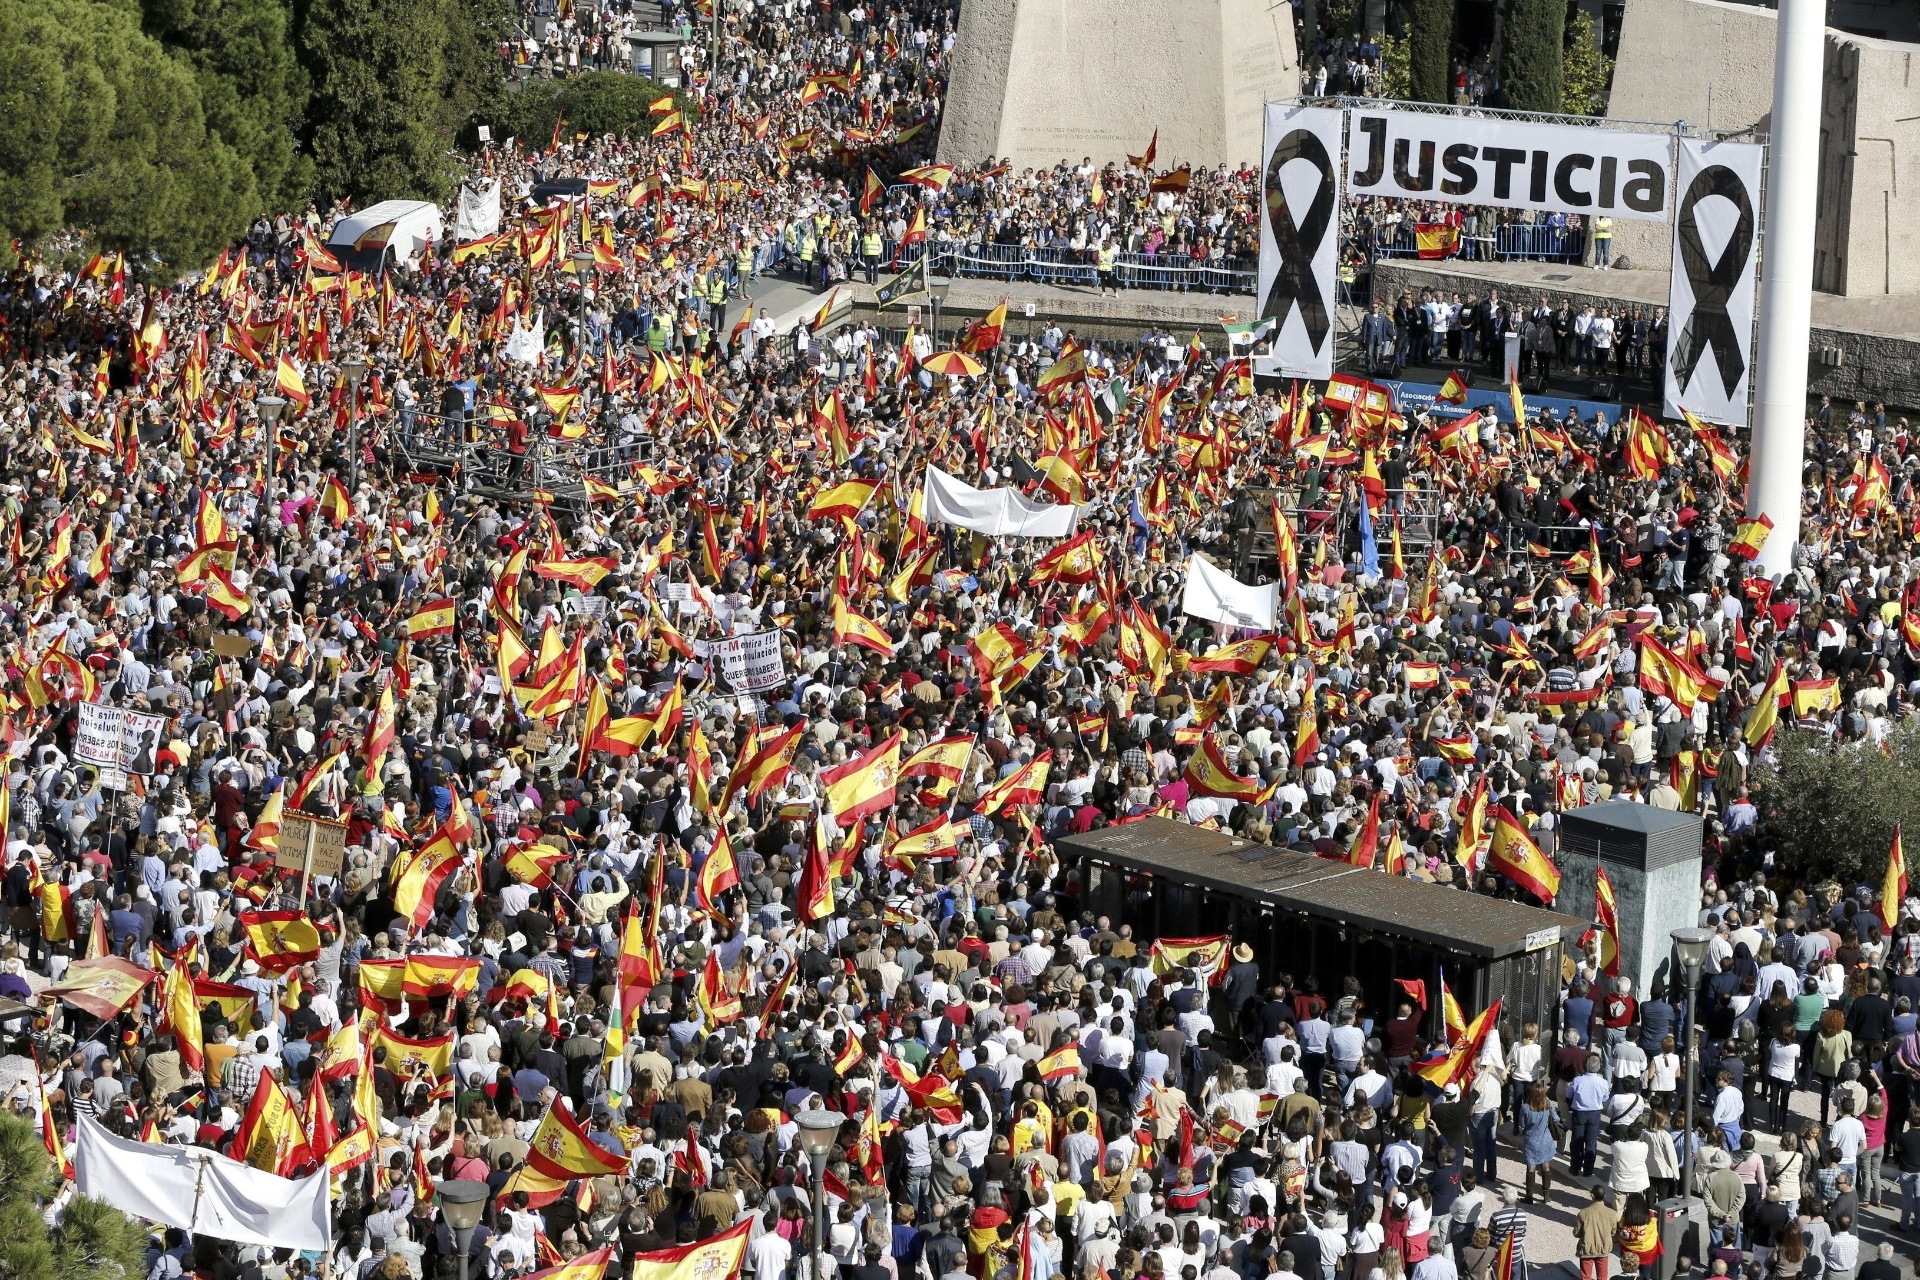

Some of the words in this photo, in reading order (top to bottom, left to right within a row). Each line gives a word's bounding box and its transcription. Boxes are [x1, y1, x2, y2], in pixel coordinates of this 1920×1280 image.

[730, 646, 778, 662] manpulación
[316, 831, 328, 844] CON
[332, 834, 343, 847] LAS
[320, 847, 333, 858] PAZ
[313, 858, 340, 871] JUSTICIA
